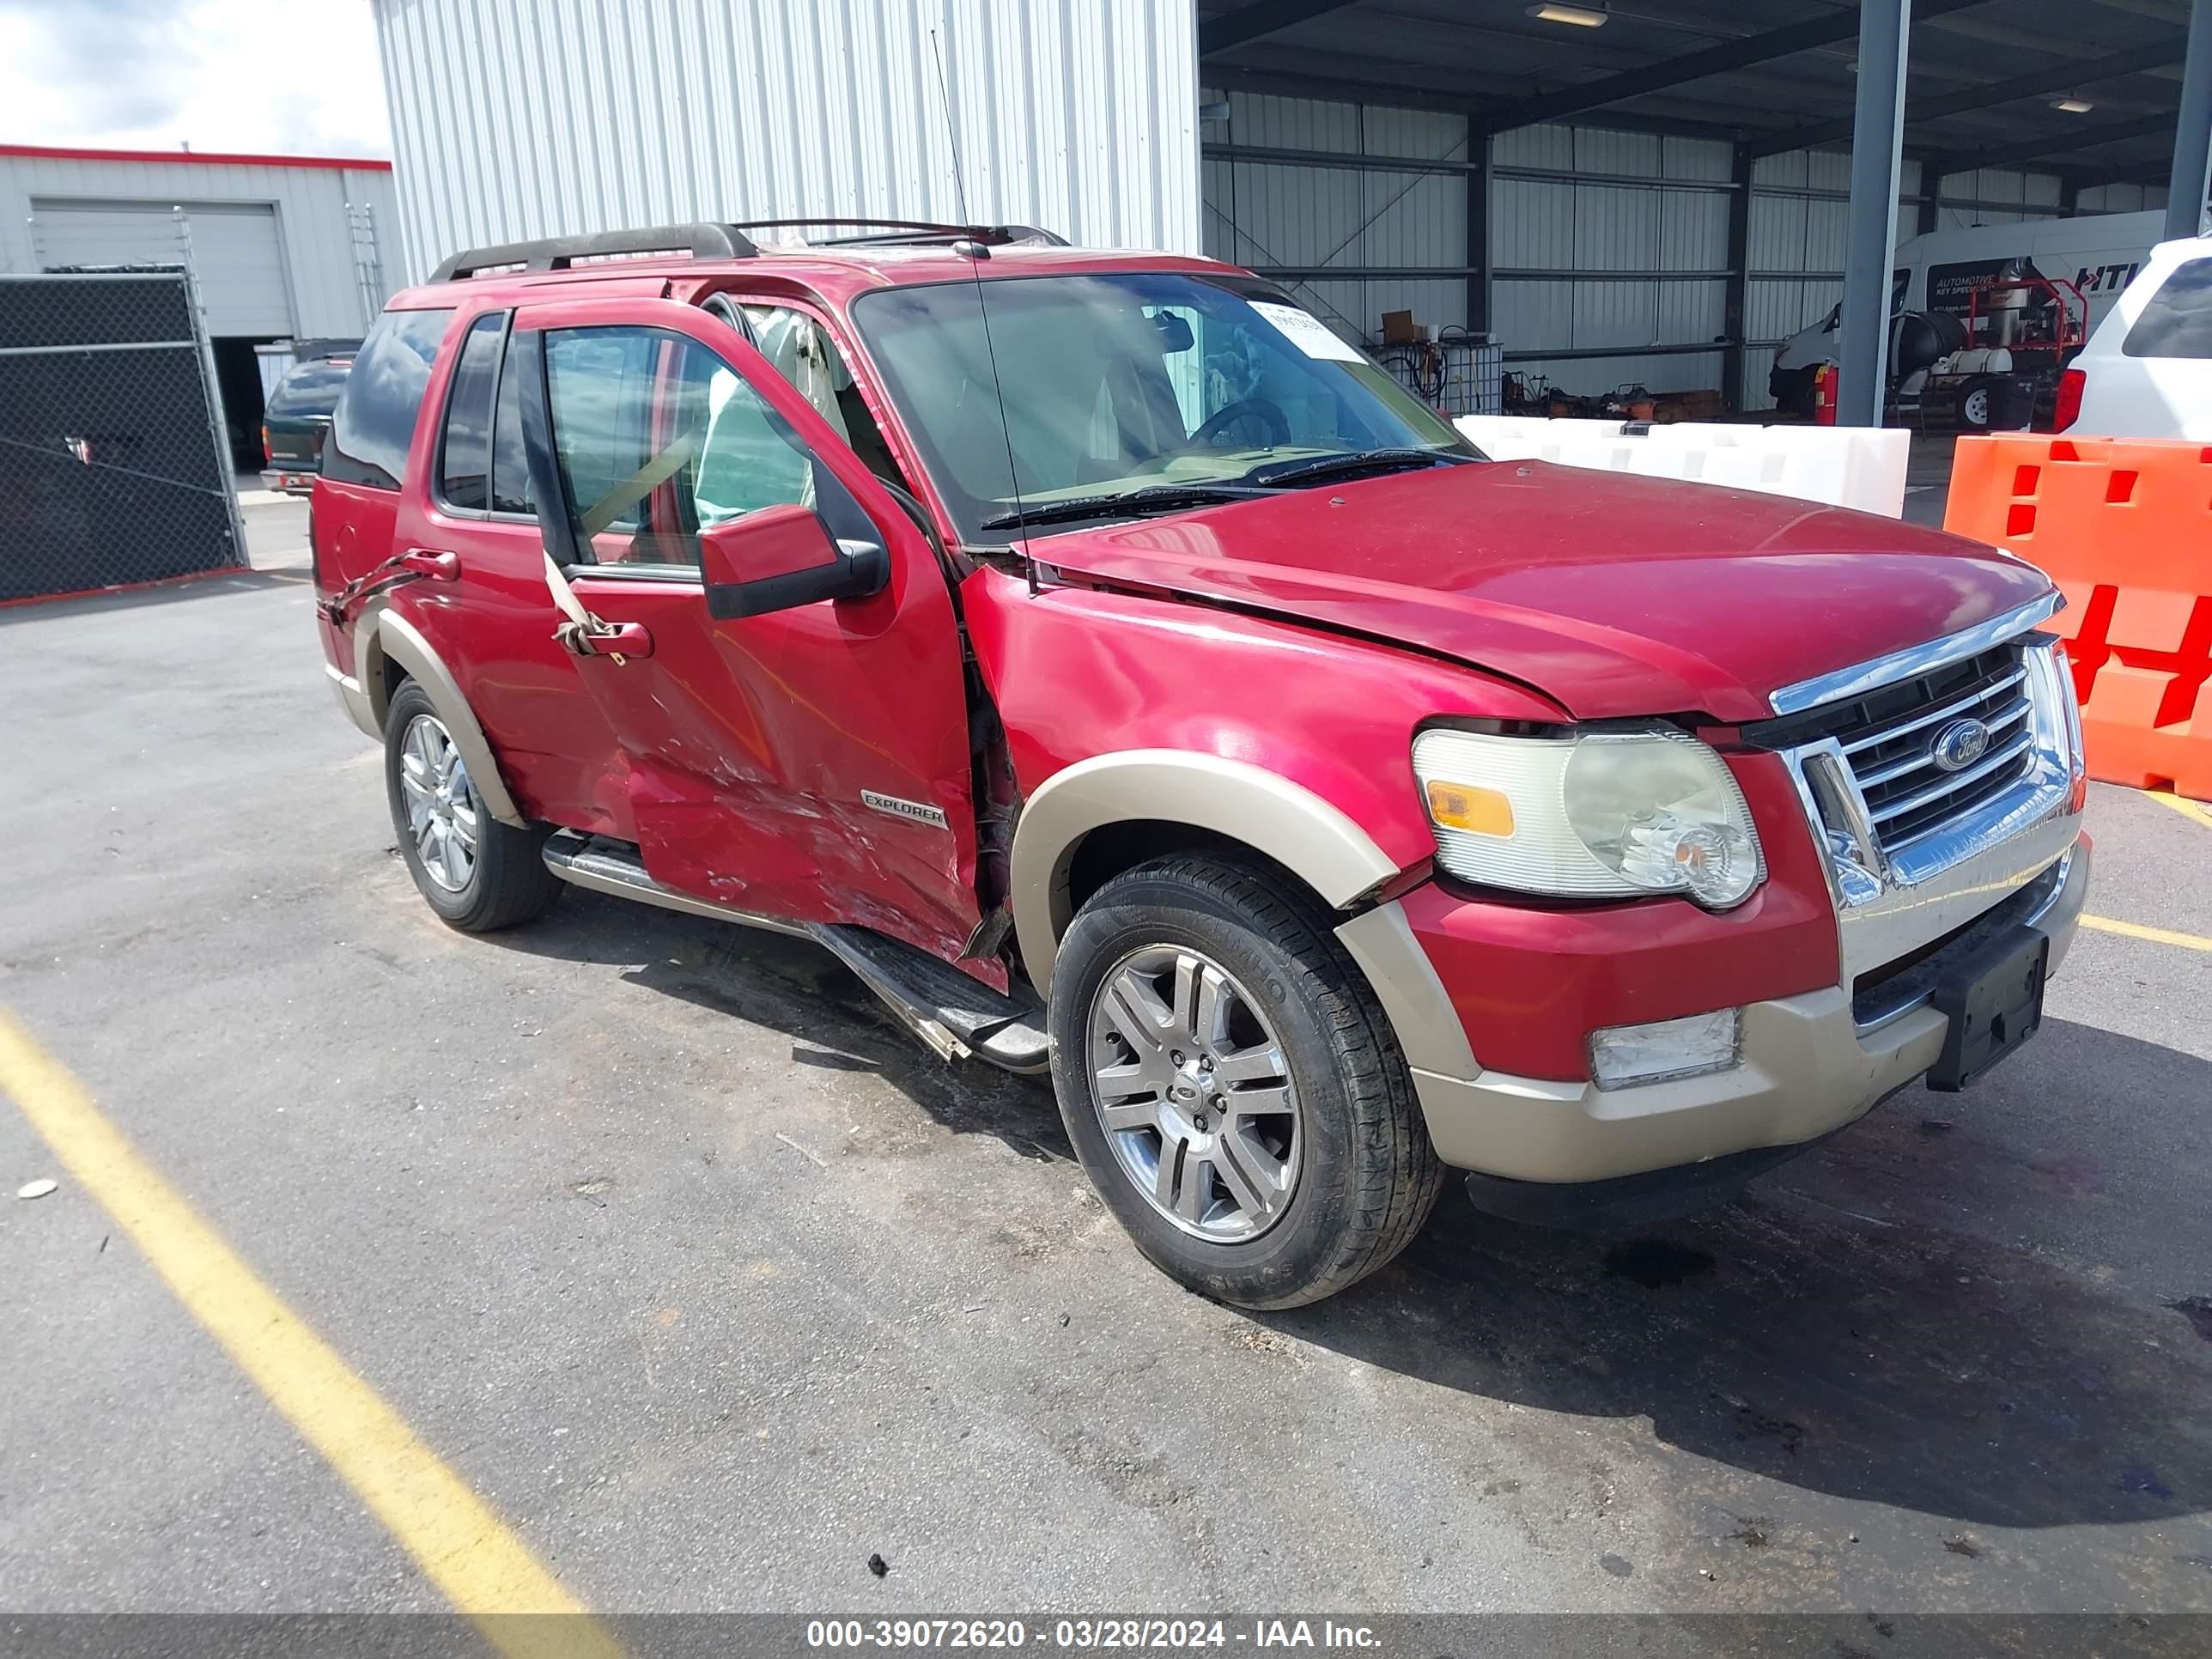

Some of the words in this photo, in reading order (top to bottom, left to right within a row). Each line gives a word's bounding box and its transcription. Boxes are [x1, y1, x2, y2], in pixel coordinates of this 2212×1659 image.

[1936, 274, 1995, 288] AUTOMOTIVE
[1936, 288, 1951, 296] KEY
[1957, 726, 1984, 760] Ford
[865, 794, 943, 823] EXPLORER
